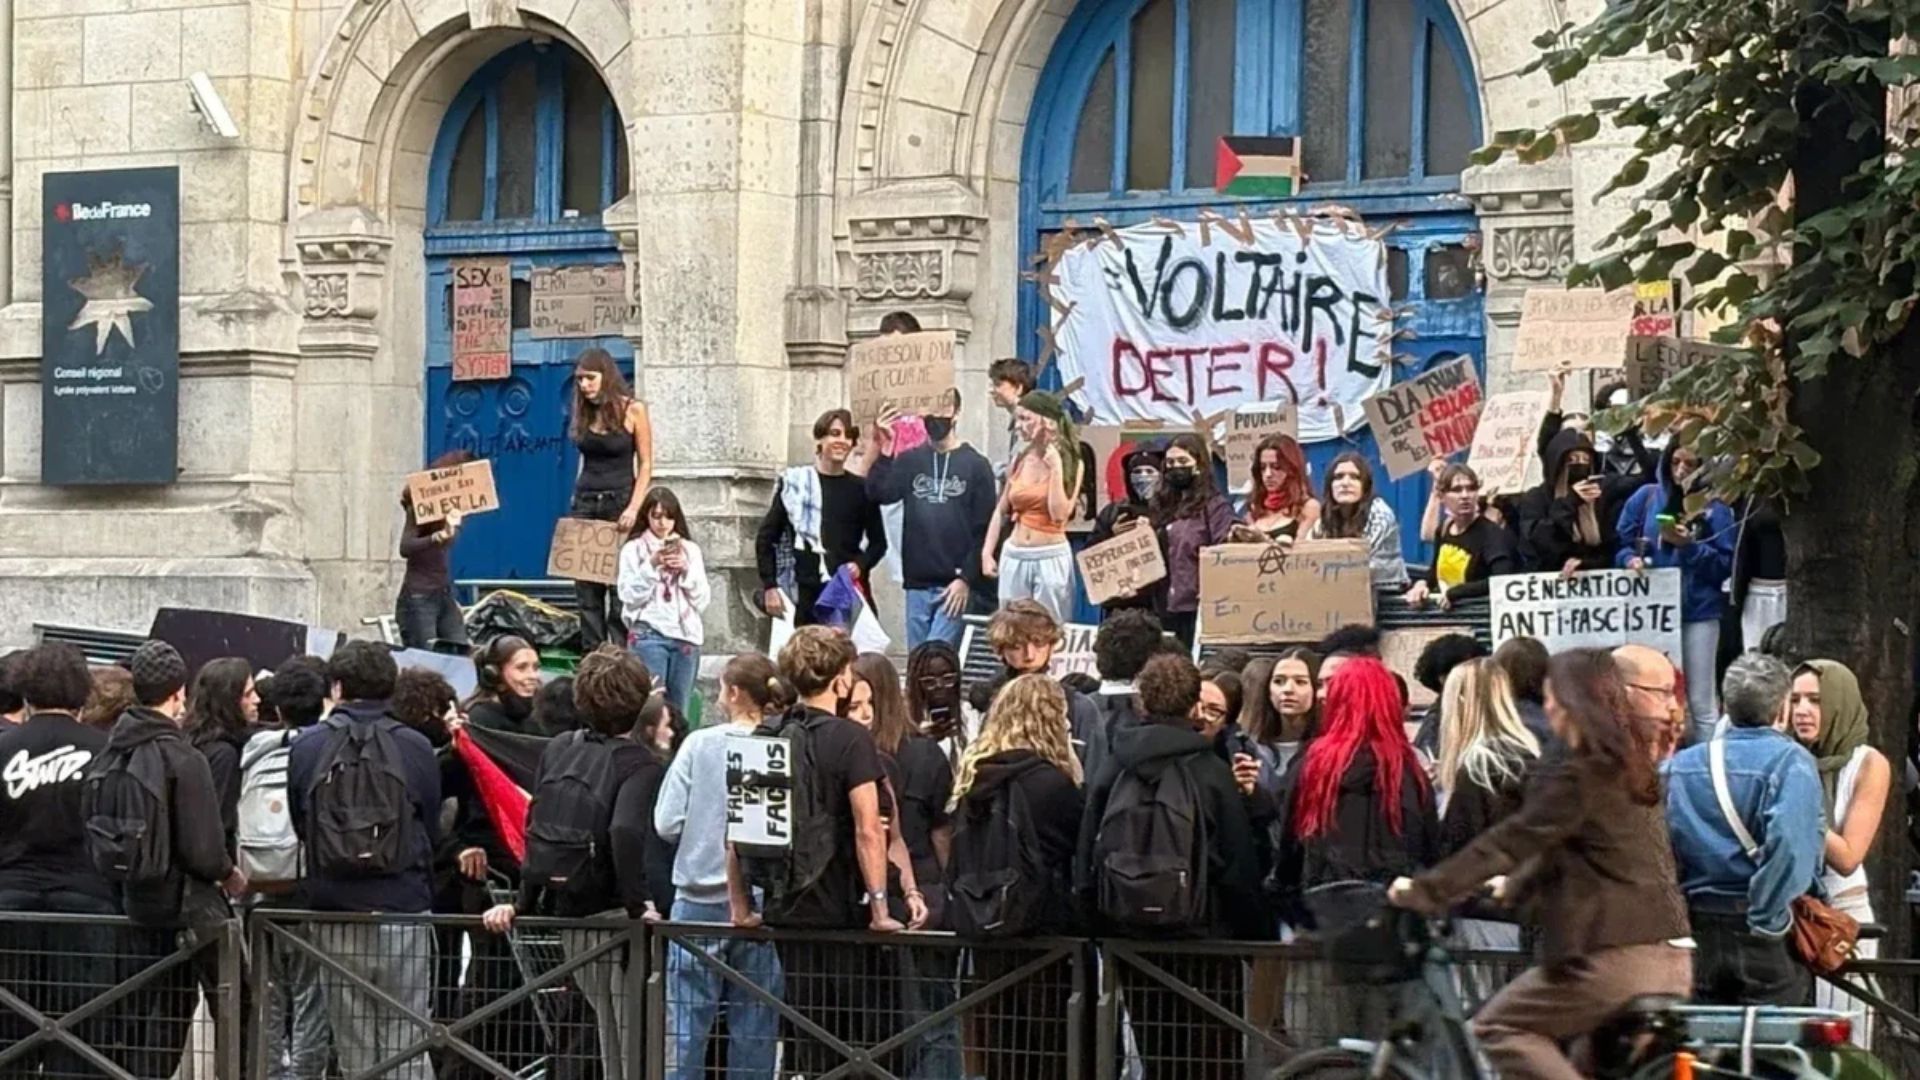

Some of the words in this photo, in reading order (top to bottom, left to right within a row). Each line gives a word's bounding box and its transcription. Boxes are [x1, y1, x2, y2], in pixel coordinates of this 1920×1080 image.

[456, 266, 491, 288] SEX
[417, 502, 435, 518] ON
[1214, 597, 1240, 617] En
